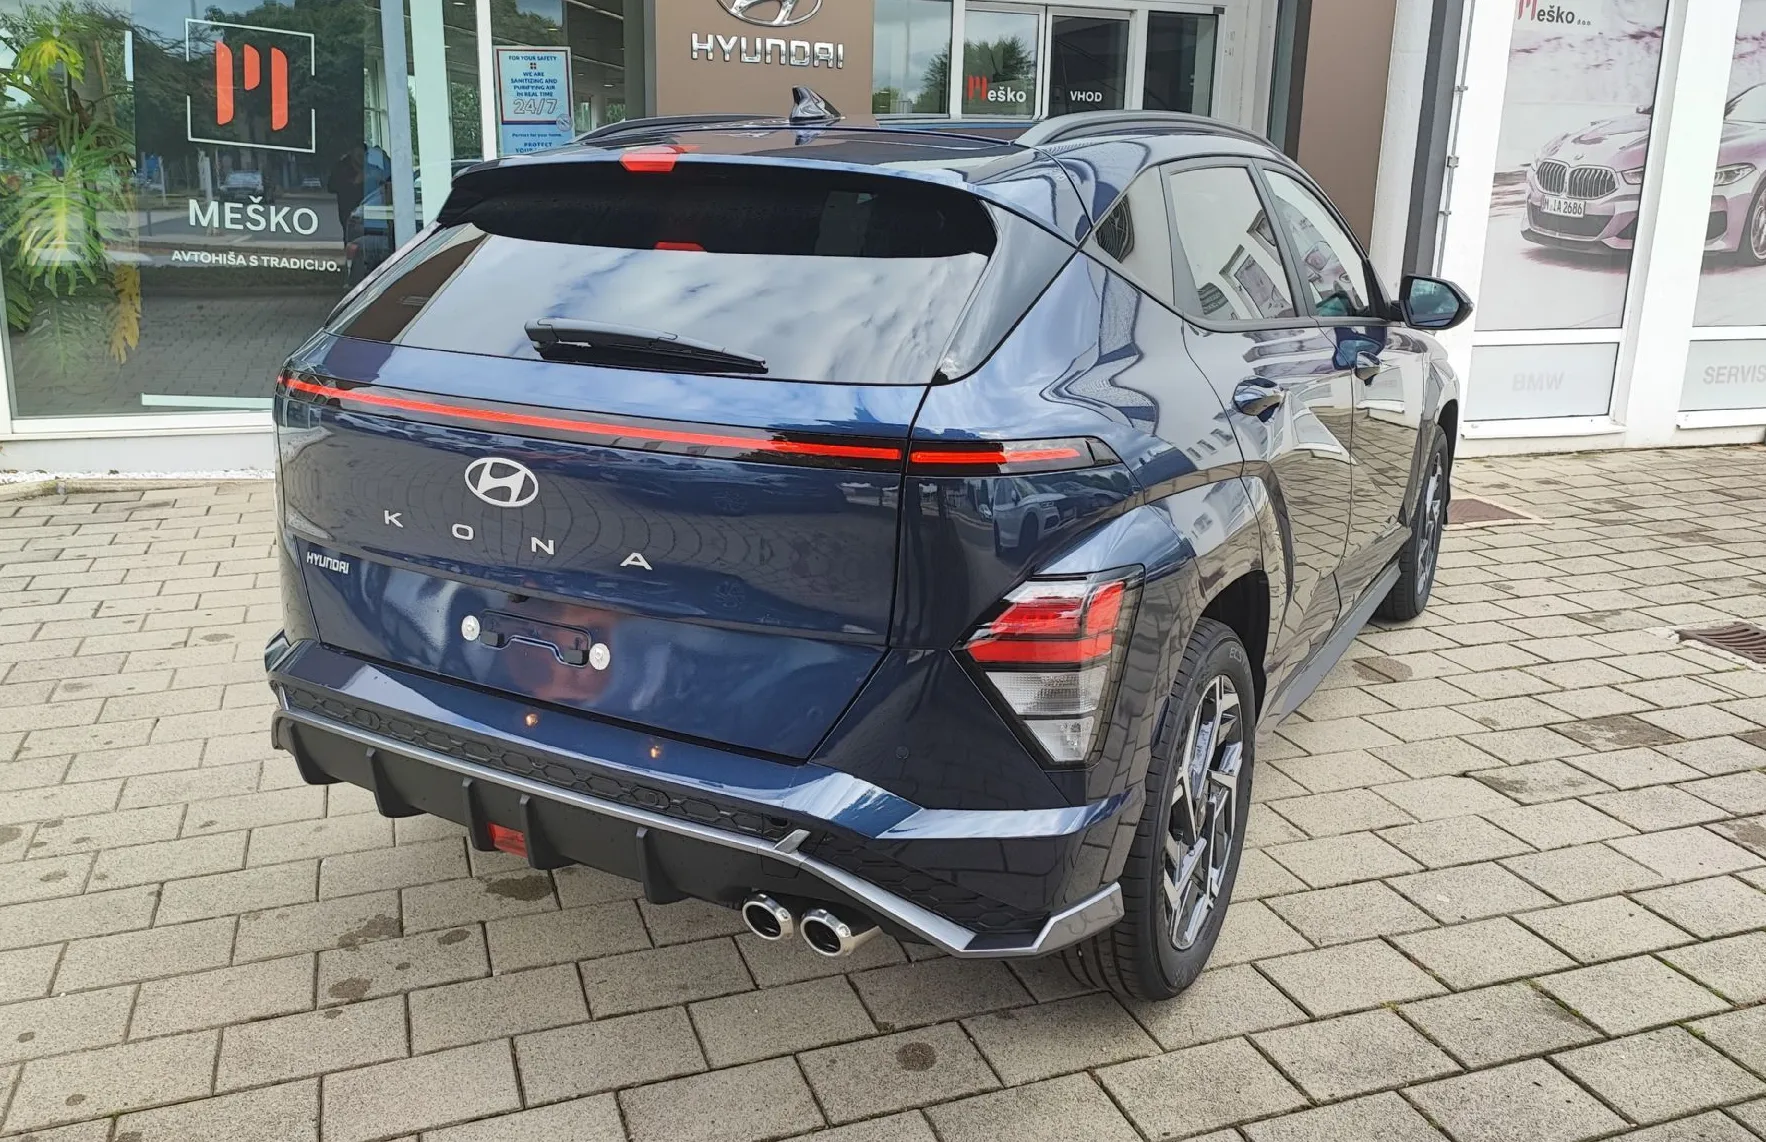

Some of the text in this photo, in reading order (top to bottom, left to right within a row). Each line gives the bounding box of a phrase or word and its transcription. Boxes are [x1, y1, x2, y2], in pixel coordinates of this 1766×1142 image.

[691, 33, 844, 69] HYUNDAI
[513, 98, 558, 115] 24/7
[1070, 90, 1103, 102] VHOD
[189, 195, 319, 235] MEŠKO
[1563, 201, 1583, 216] 2686
[171, 250, 341, 272] AVTOHIŠA S TRADICIJO.
[1511, 371, 1565, 391] BMW
[1702, 364, 1766, 385] SERVIS
[384, 510, 653, 571] KONA
[306, 551, 350, 575] HYUNDAI
